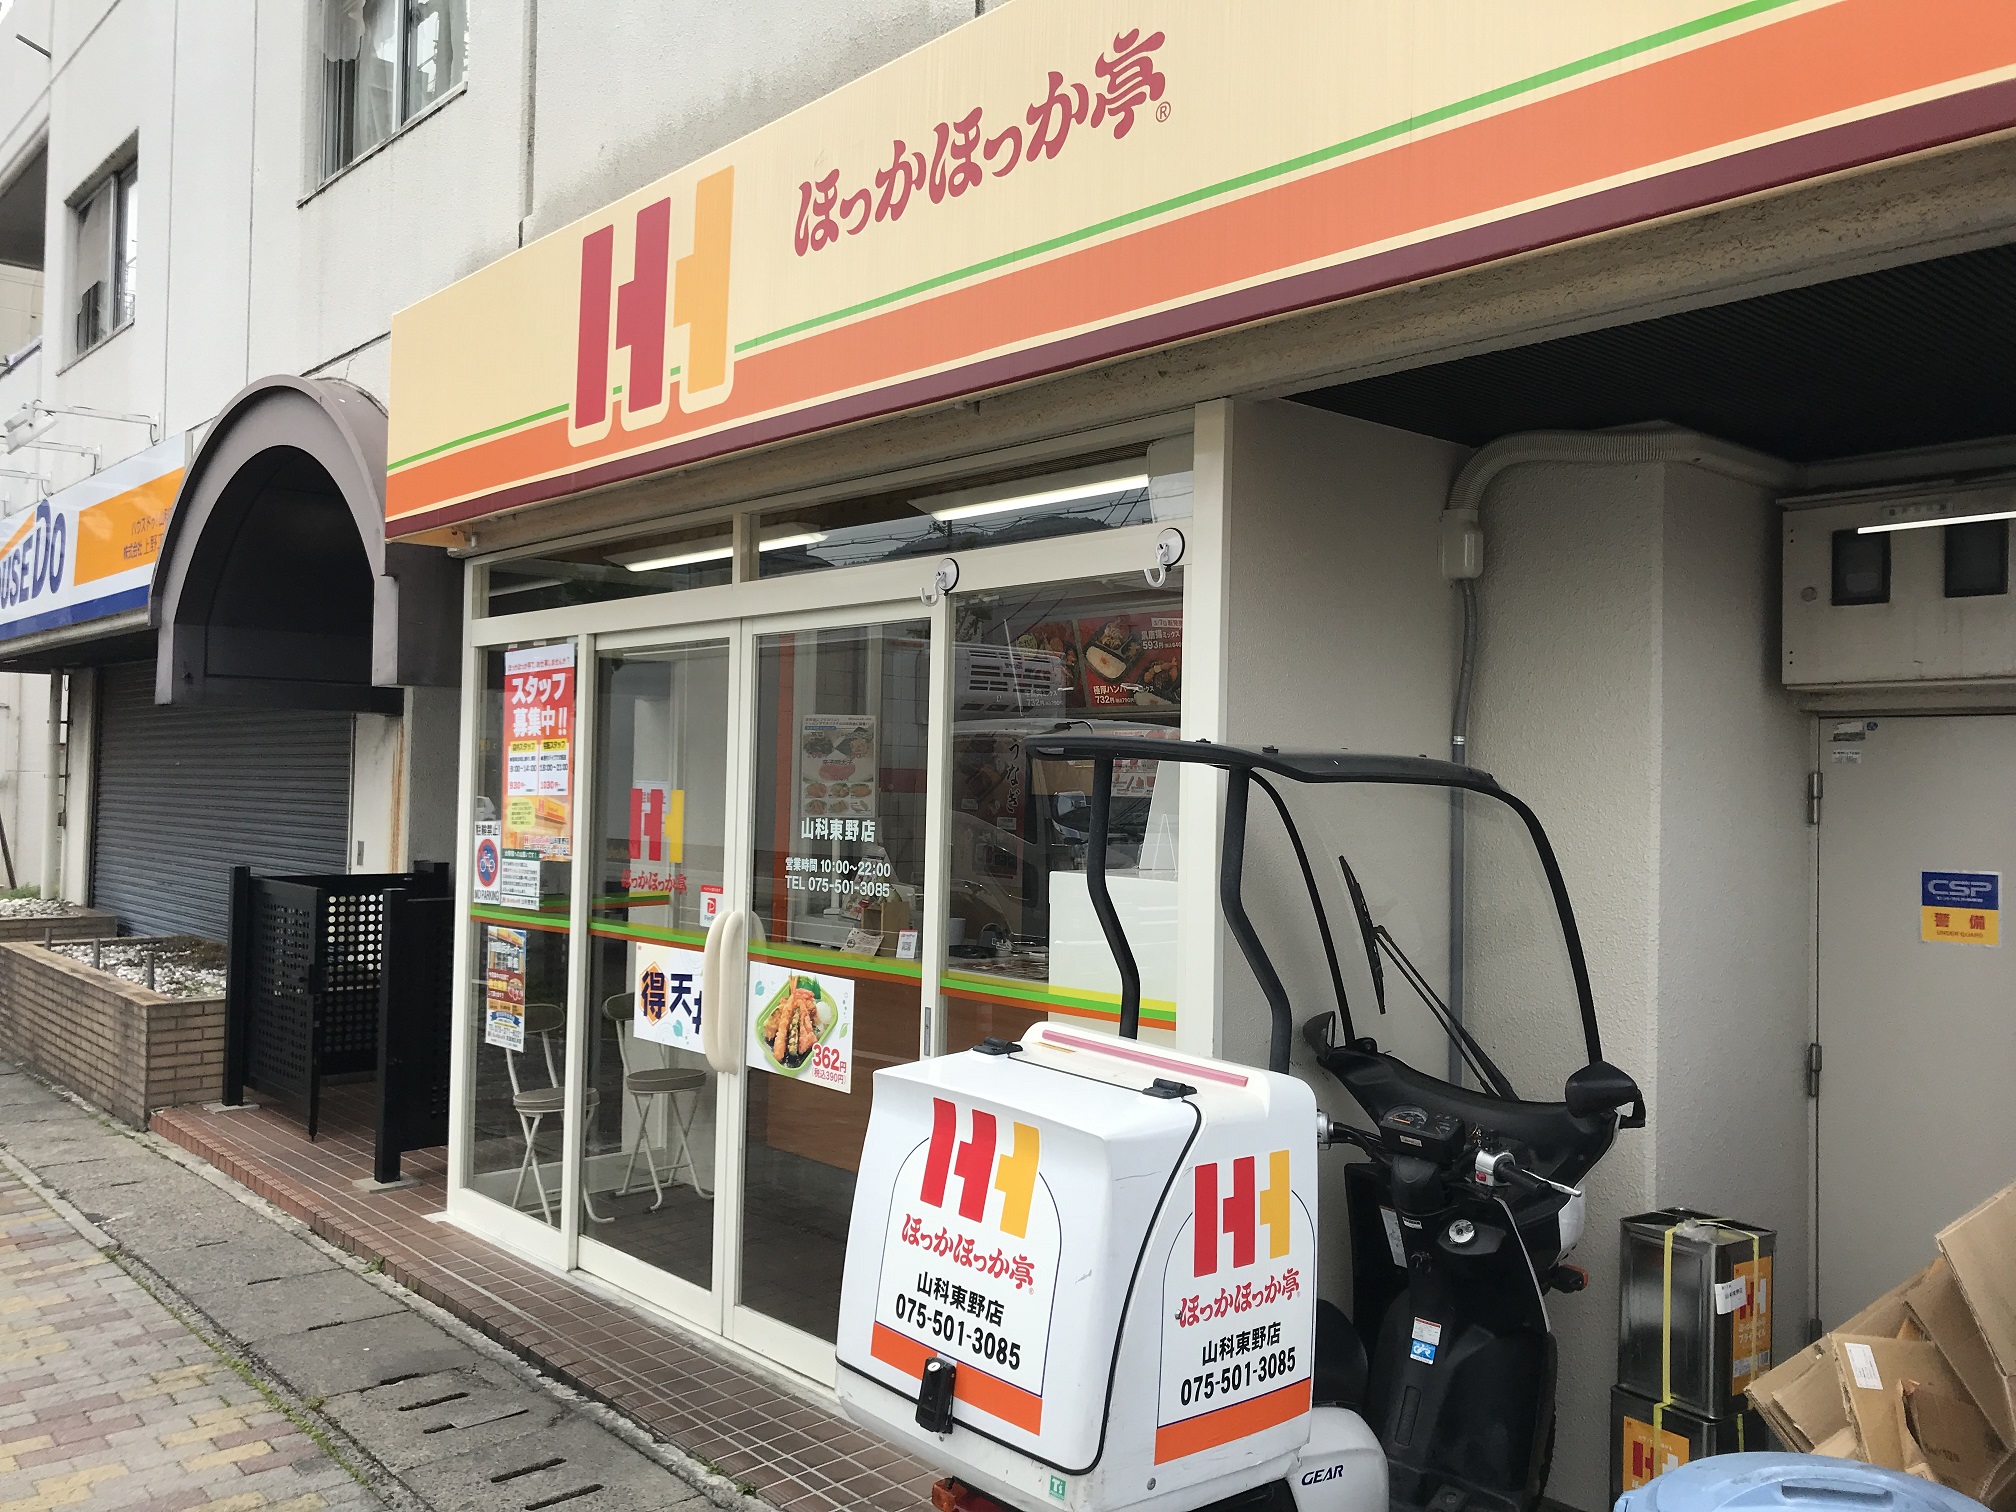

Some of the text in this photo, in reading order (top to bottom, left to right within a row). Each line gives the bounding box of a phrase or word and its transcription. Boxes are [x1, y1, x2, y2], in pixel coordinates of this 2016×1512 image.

[793, 27, 1167, 258] ほっかほっか亭
[511, 672, 567, 705] スタッフ
[800, 816, 876, 843] 山科東野店
[620, 868, 688, 896] ほっかほっか亭
[785, 856, 818, 873] 営業時間
[784, 875, 891, 898] TEL 075-501-3085
[812, 1044, 847, 1073] 362円
[901, 1213, 1035, 1290] ほっかほっか亭
[916, 1271, 1005, 1327] 山科東野店
[1179, 1266, 1300, 1329] ほっかほっか亭
[895, 1293, 1021, 1371] 075-501-3085
[1202, 1321, 1281, 1367] 山科東野店
[1180, 1346, 1296, 1406] 075-501-3085
[1301, 1464, 1345, 1487] GEAR
